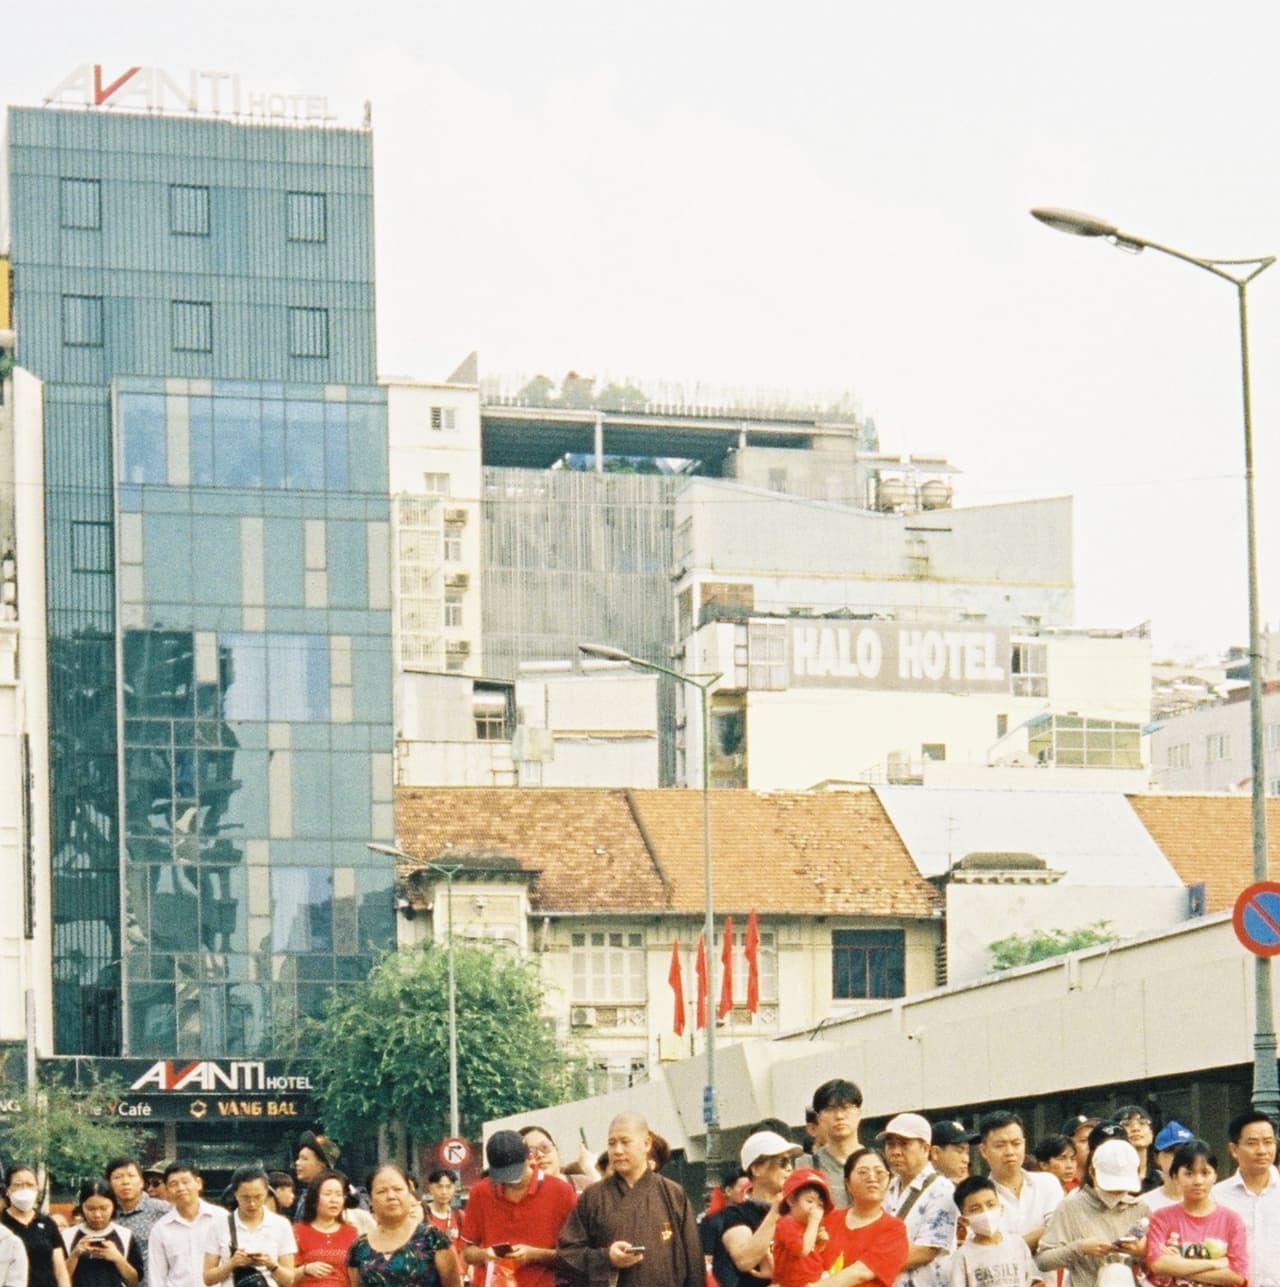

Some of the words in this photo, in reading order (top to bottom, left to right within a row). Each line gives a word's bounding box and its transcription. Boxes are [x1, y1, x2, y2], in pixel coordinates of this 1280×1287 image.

[43, 63, 241, 112] AVANTI
[248, 92, 338, 120] HOTEL
[793, 626, 883, 679] HALO
[898, 629, 1005, 681] HOTEL
[130, 1061, 265, 1091] AVANTI
[266, 1076, 313, 1090] HOTEL
